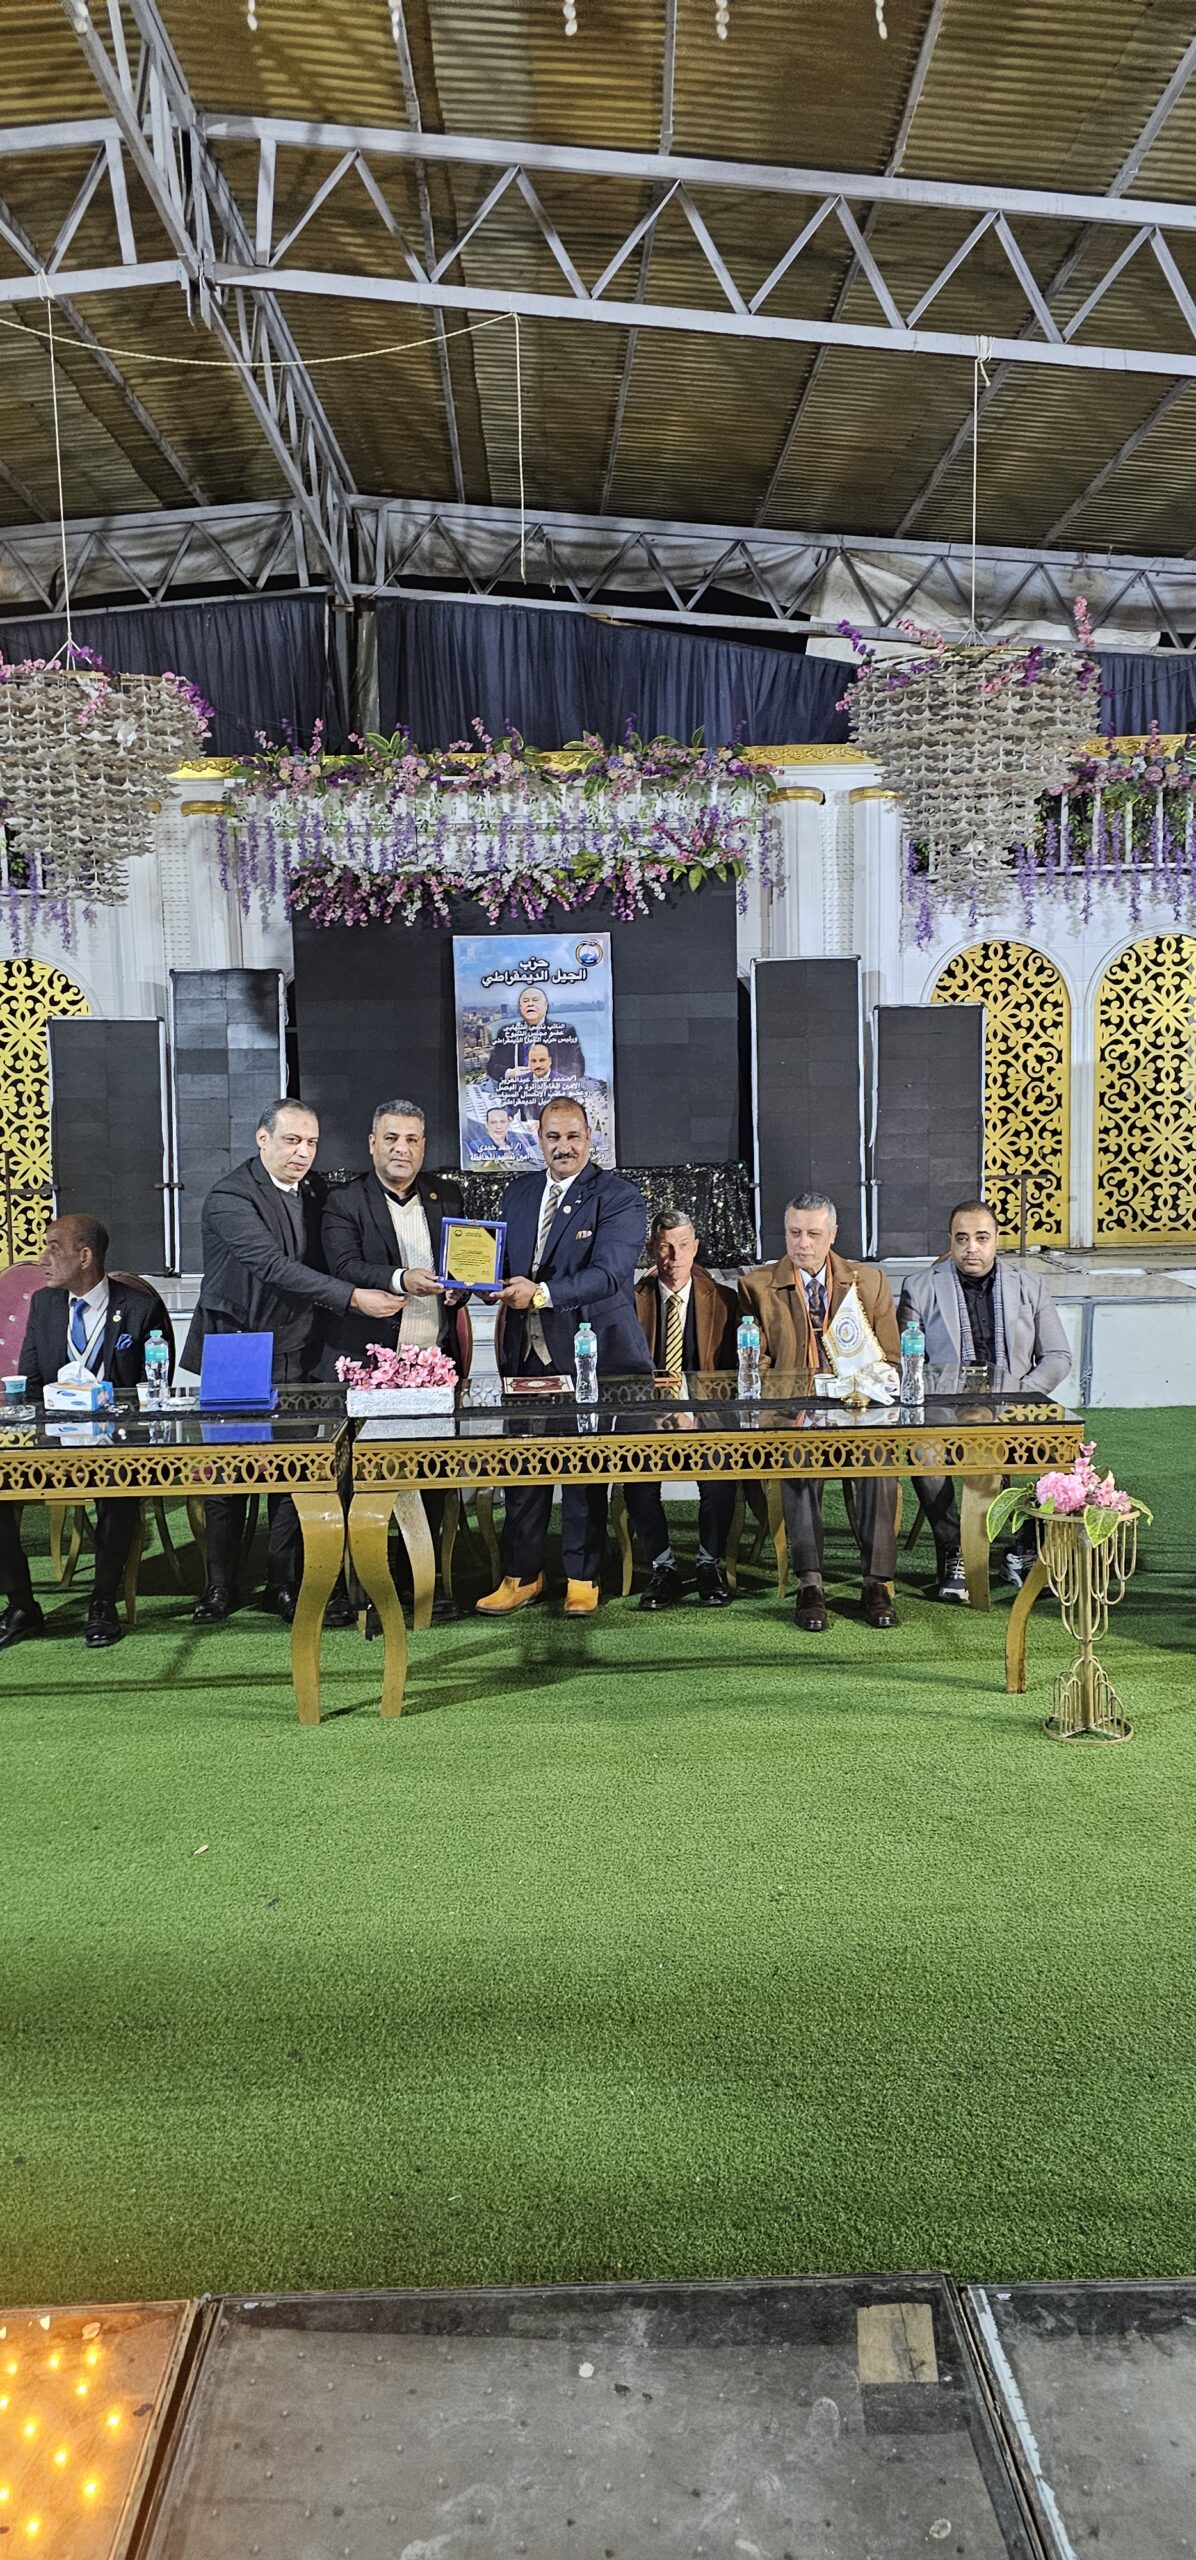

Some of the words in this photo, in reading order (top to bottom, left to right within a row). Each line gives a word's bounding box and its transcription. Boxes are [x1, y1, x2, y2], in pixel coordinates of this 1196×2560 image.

[519, 956, 549, 971] حزب
[481, 969, 549, 988] الديمقراطي
[552, 968, 587, 984] الجيل
[528, 1029, 547, 1038] مجلس
